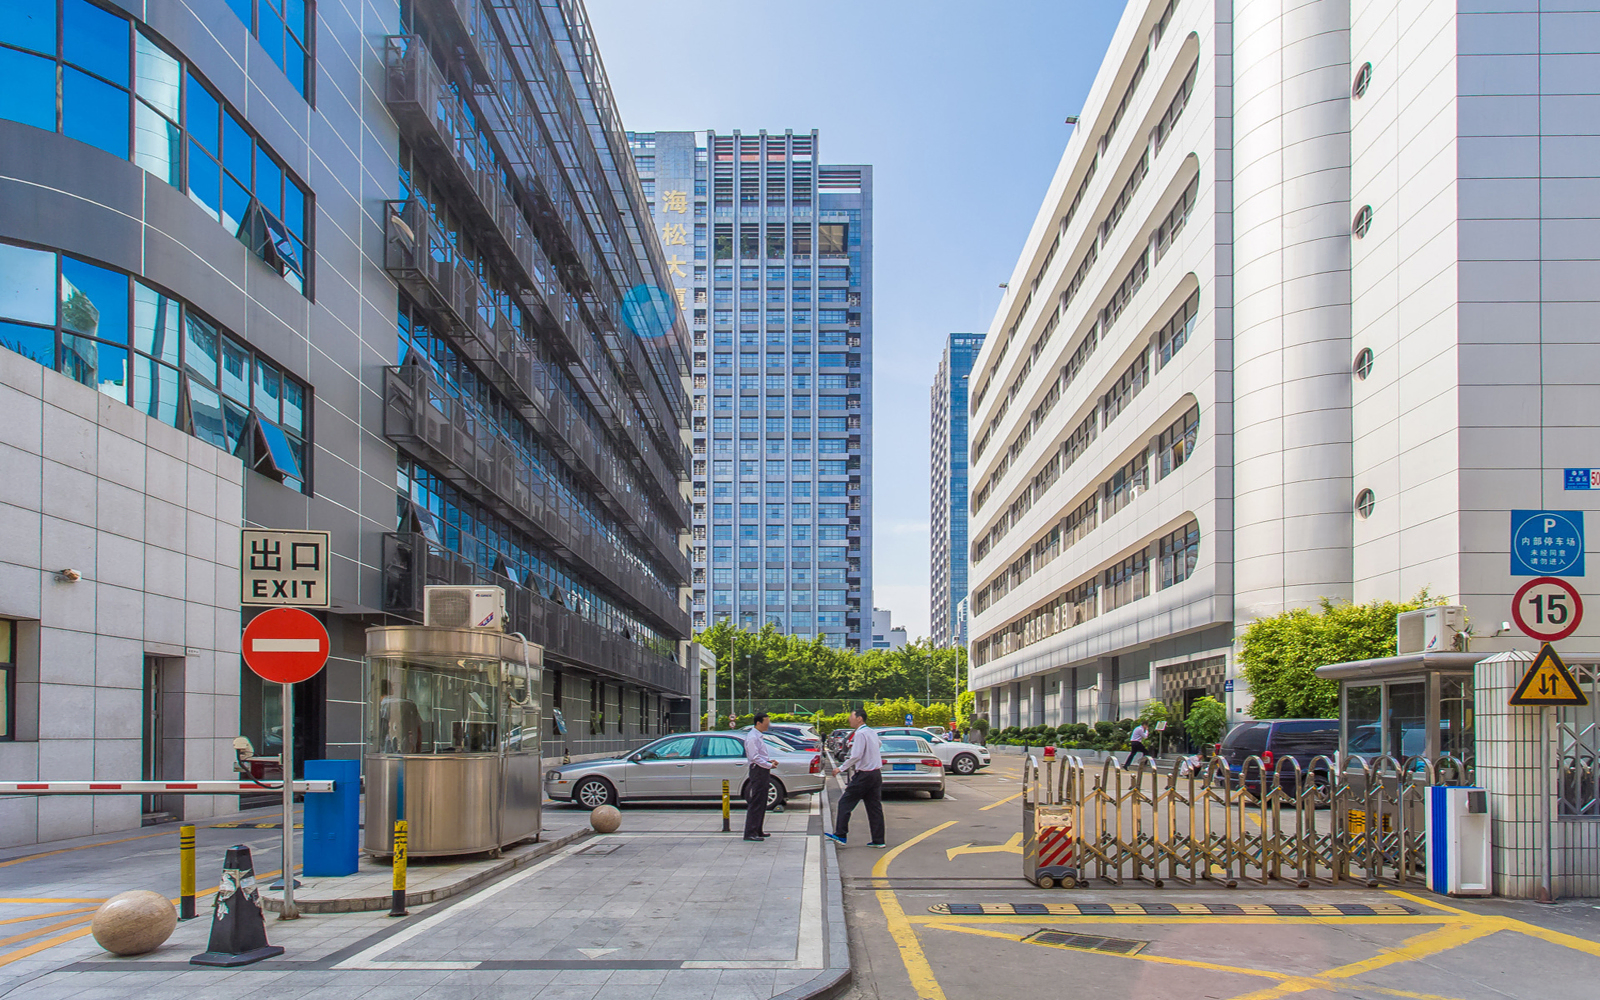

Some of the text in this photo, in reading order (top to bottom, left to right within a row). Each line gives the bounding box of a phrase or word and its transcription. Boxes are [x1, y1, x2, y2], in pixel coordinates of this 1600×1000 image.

[1543, 518, 1556, 533] P
[1521, 537, 1576, 547] 内部停车场
[250, 538, 319, 572] 出口
[1530, 549, 1566, 557] 未经同意
[252, 579, 316, 598] EXIT
[1528, 594, 1568, 624] 15
